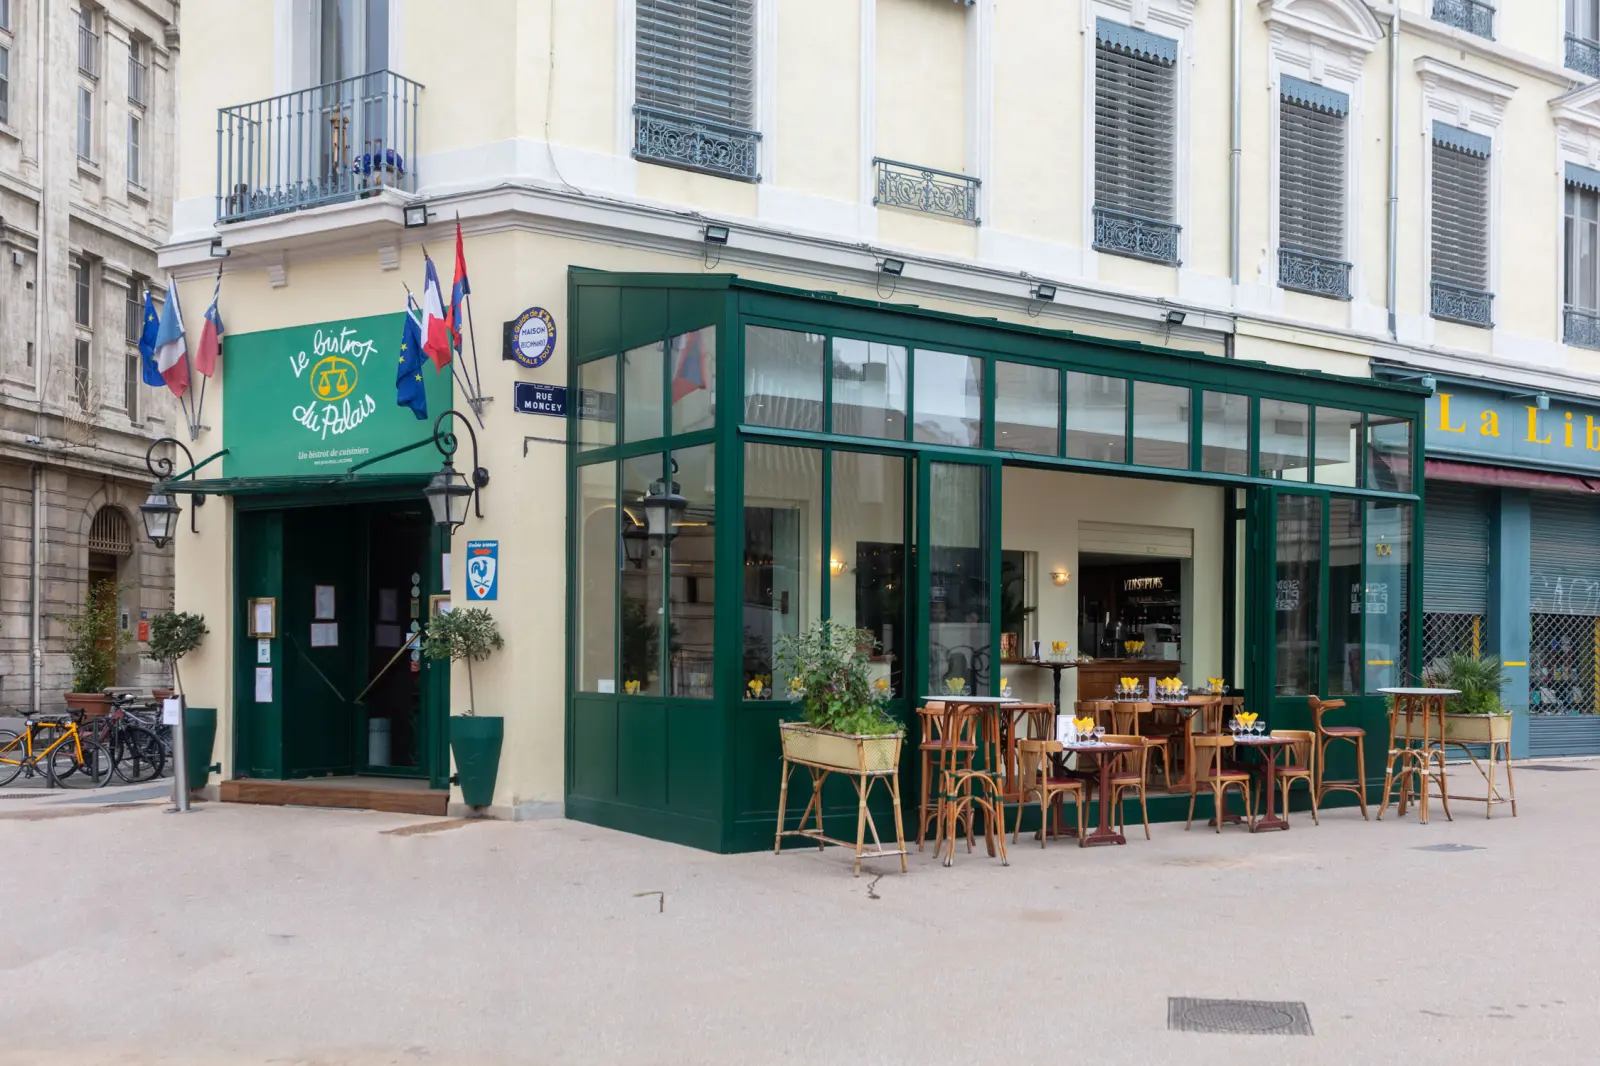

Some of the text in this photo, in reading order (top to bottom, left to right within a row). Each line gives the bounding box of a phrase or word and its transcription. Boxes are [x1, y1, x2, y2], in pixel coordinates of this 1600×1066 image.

[514, 314, 529, 332] Guide
[522, 326, 546, 336] MAISON
[313, 326, 378, 365] bistrot
[515, 344, 552, 364] SIGNALE TOUT
[536, 392, 552, 400] RUE
[524, 401, 562, 412] MONCEY
[1436, 392, 1500, 438] La
[292, 394, 376, 440] du Palais
[308, 450, 329, 458] bistrot
[330, 448, 338, 456] de
[339, 446, 369, 456] cuisiniers
